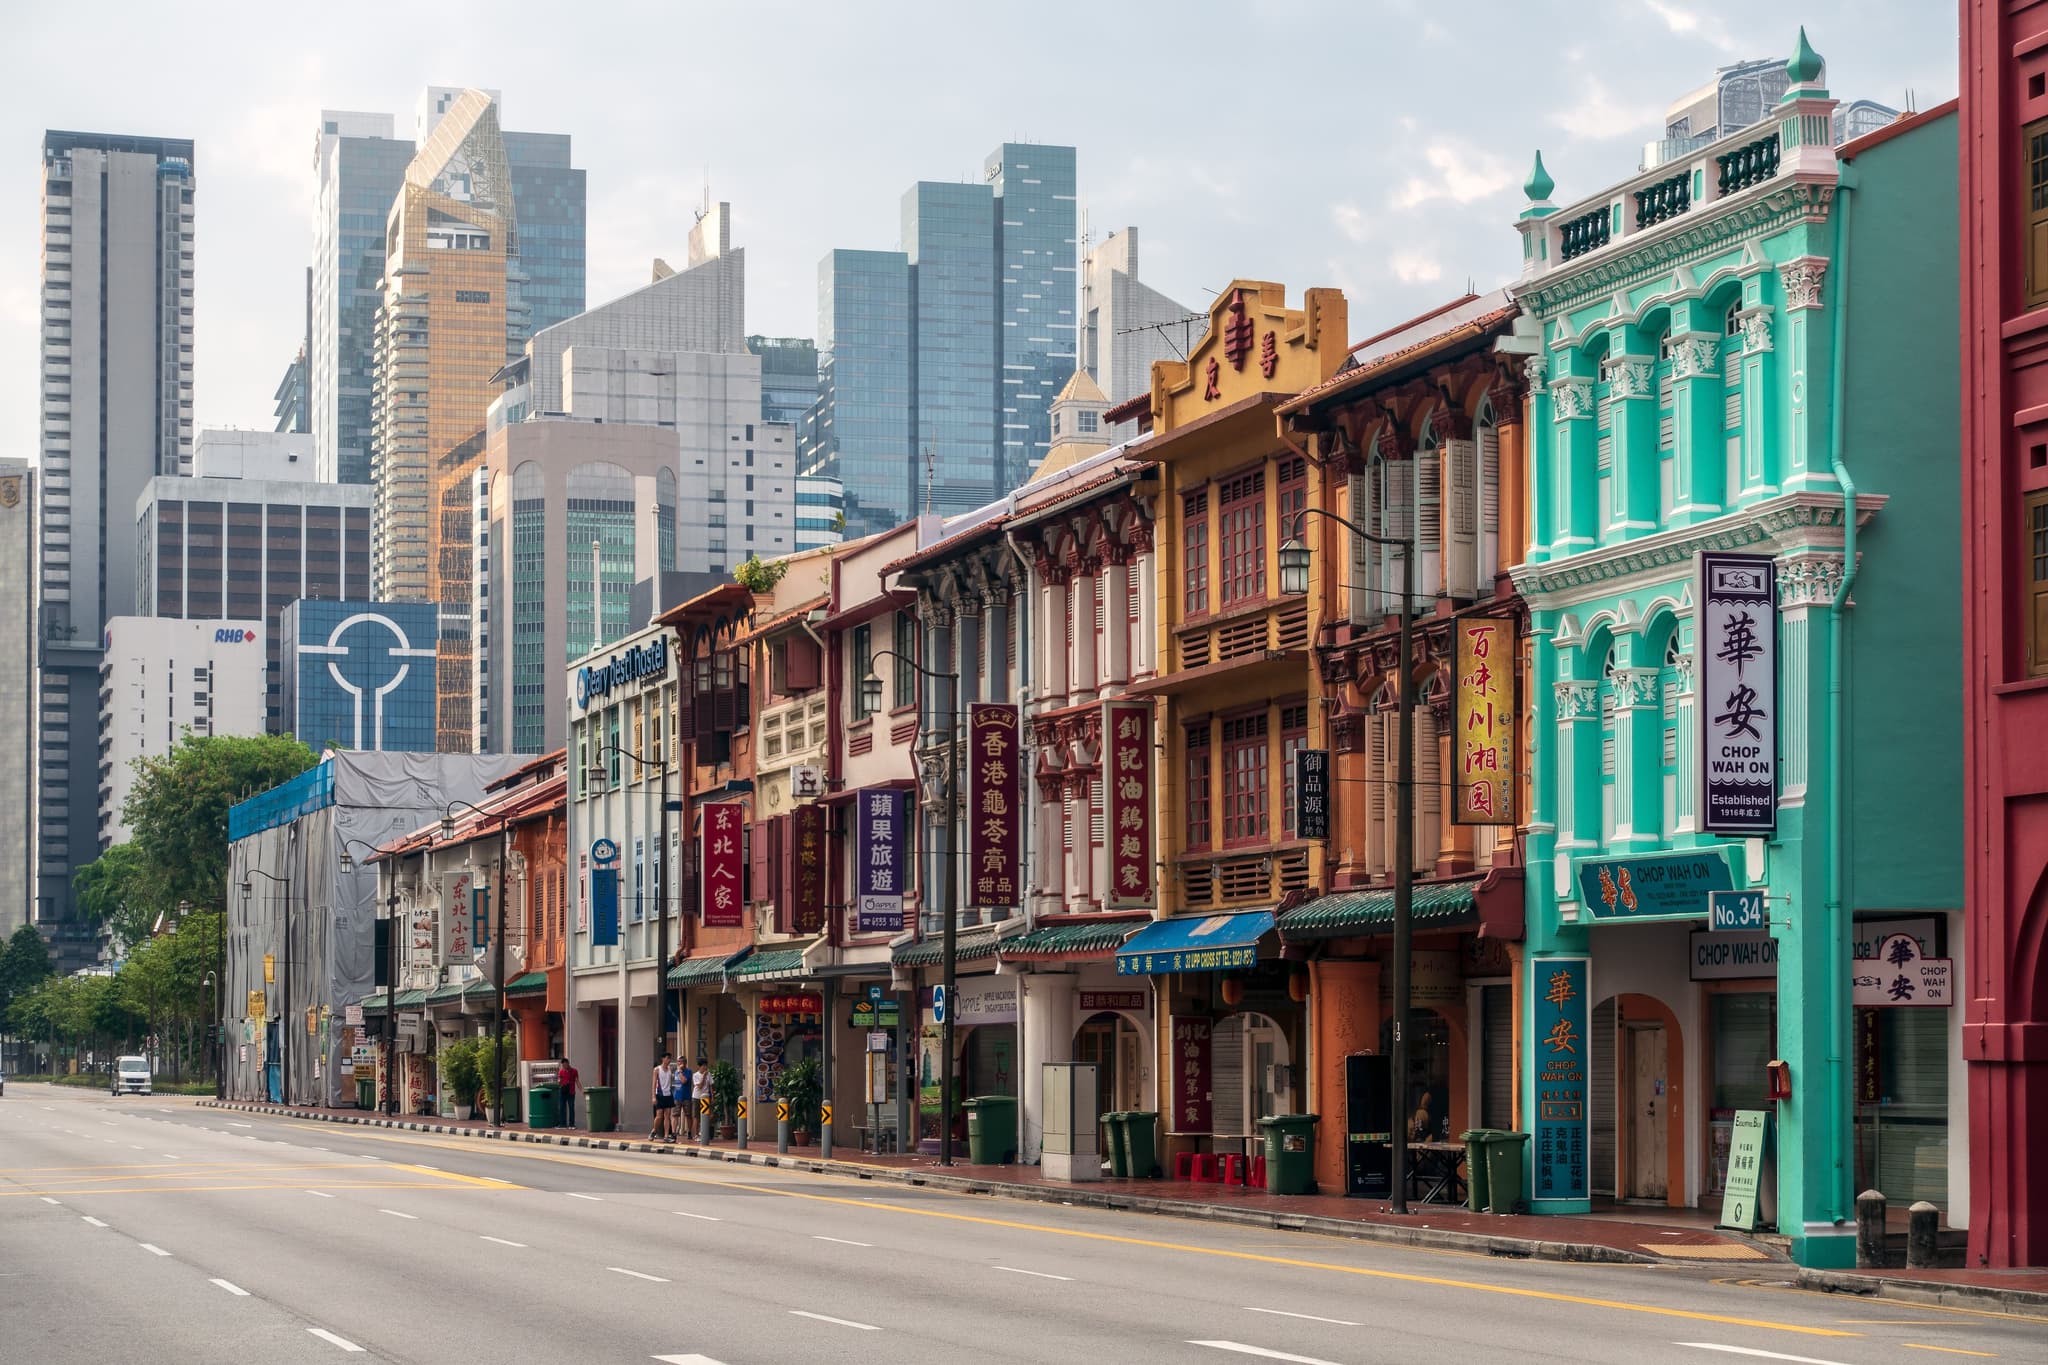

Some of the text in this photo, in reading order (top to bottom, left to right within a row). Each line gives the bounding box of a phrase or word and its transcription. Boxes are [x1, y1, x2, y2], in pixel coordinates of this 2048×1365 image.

[215, 628, 244, 643] RHB
[634, 634, 668, 677] hostel
[1714, 610, 1767, 741] 華安
[1721, 745, 1761, 759] CHOP
[1711, 761, 1770, 774] WAH ON
[1304, 753, 1323, 814] 御品源
[980, 730, 1009, 874] 香港龜苓膏
[1711, 793, 1771, 807] Established
[711, 807, 736, 910] 东北人家
[1636, 862, 1711, 884] CHOP WAH ON
[977, 877, 1013, 893] 甜品
[978, 895, 996, 905] No.
[449, 881, 469, 955] 东北小厨
[1200, 951, 1216, 968] CROSS
[1697, 941, 1778, 966] CHOP WAH ON
[1886, 938, 1917, 1002] 華安
[1920, 966, 1948, 976] CHOP
[1922, 977, 1946, 987] WAH
[1926, 988, 1942, 999] ON
[1543, 969, 1580, 1055] 華安
[1546, 1061, 1577, 1071] CHOP
[1540, 1071, 1583, 1082] WAH ON
